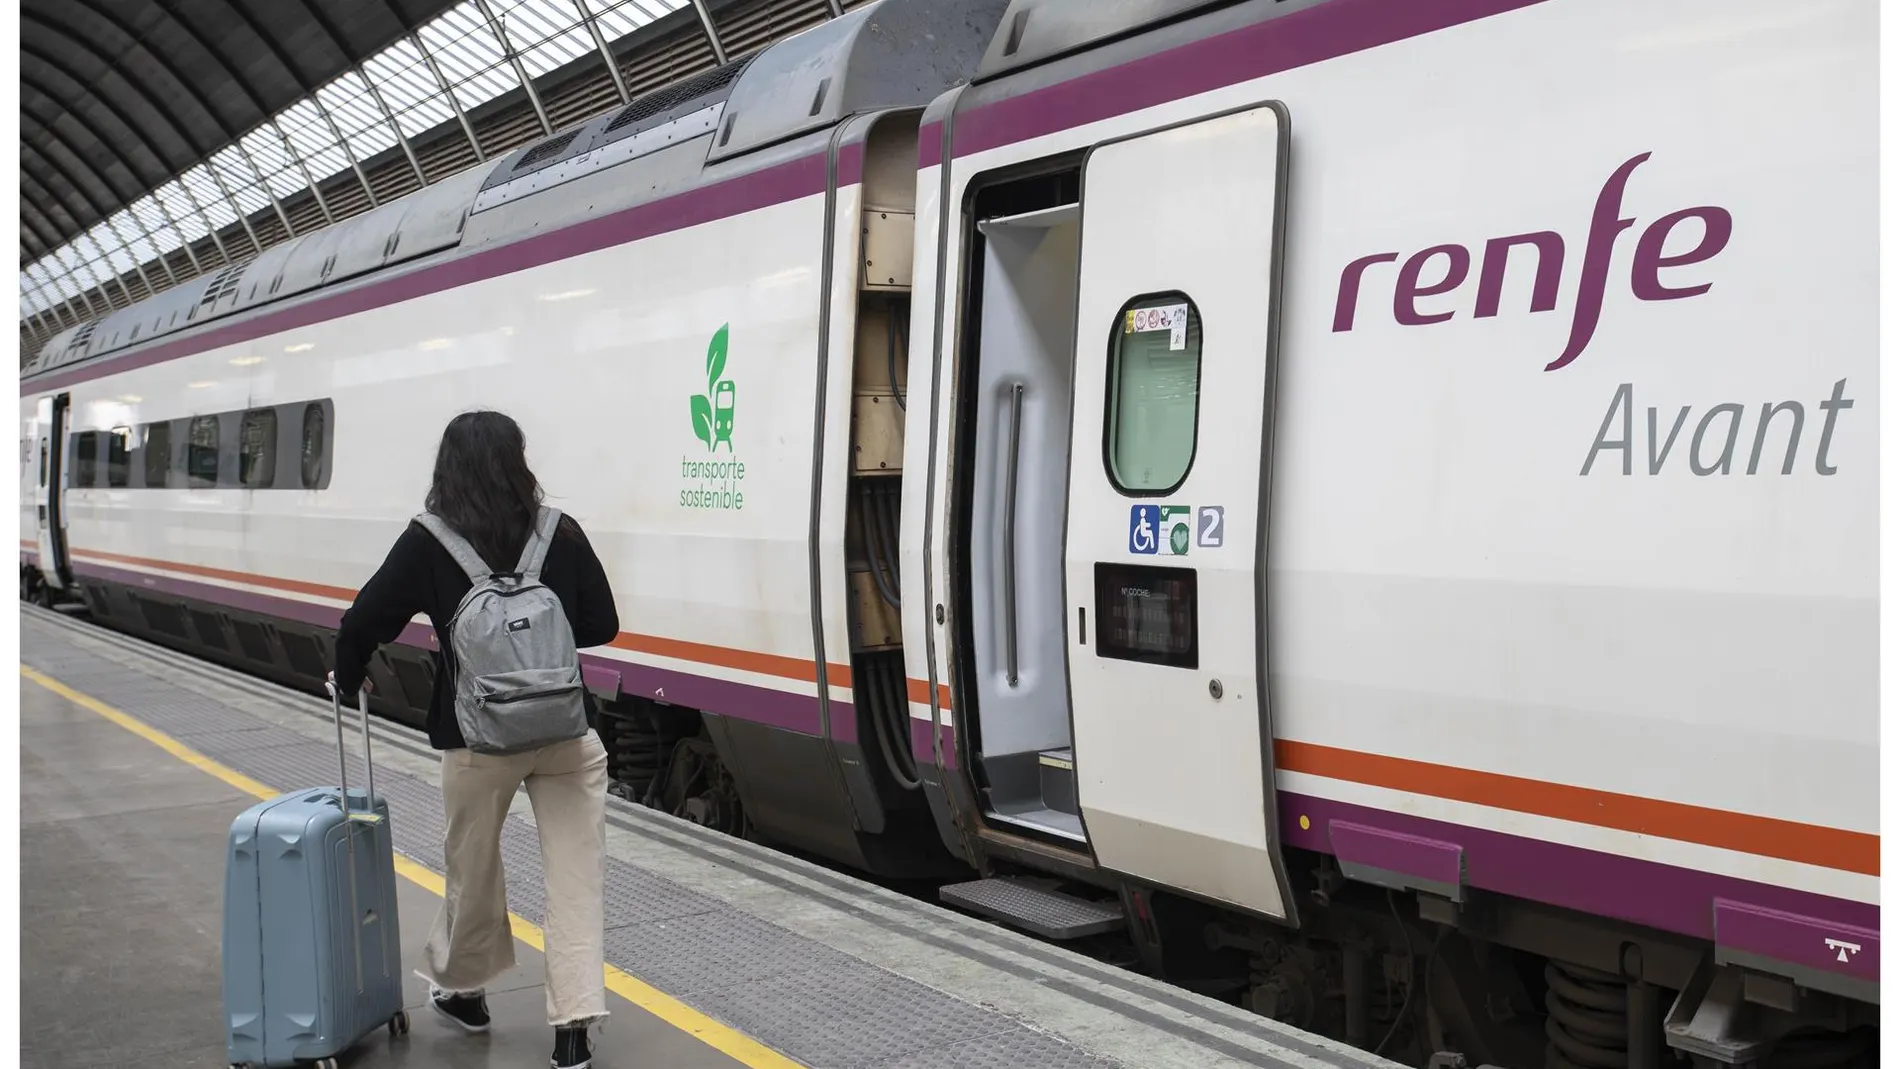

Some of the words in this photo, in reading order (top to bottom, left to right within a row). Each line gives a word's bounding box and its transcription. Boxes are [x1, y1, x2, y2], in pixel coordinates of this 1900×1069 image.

[1331, 151, 1733, 373] renfe
[1578, 377, 1855, 477] Avant
[682, 455, 745, 485] transporte
[680, 481, 744, 510] sostenible
[1200, 508, 1220, 545] 2
